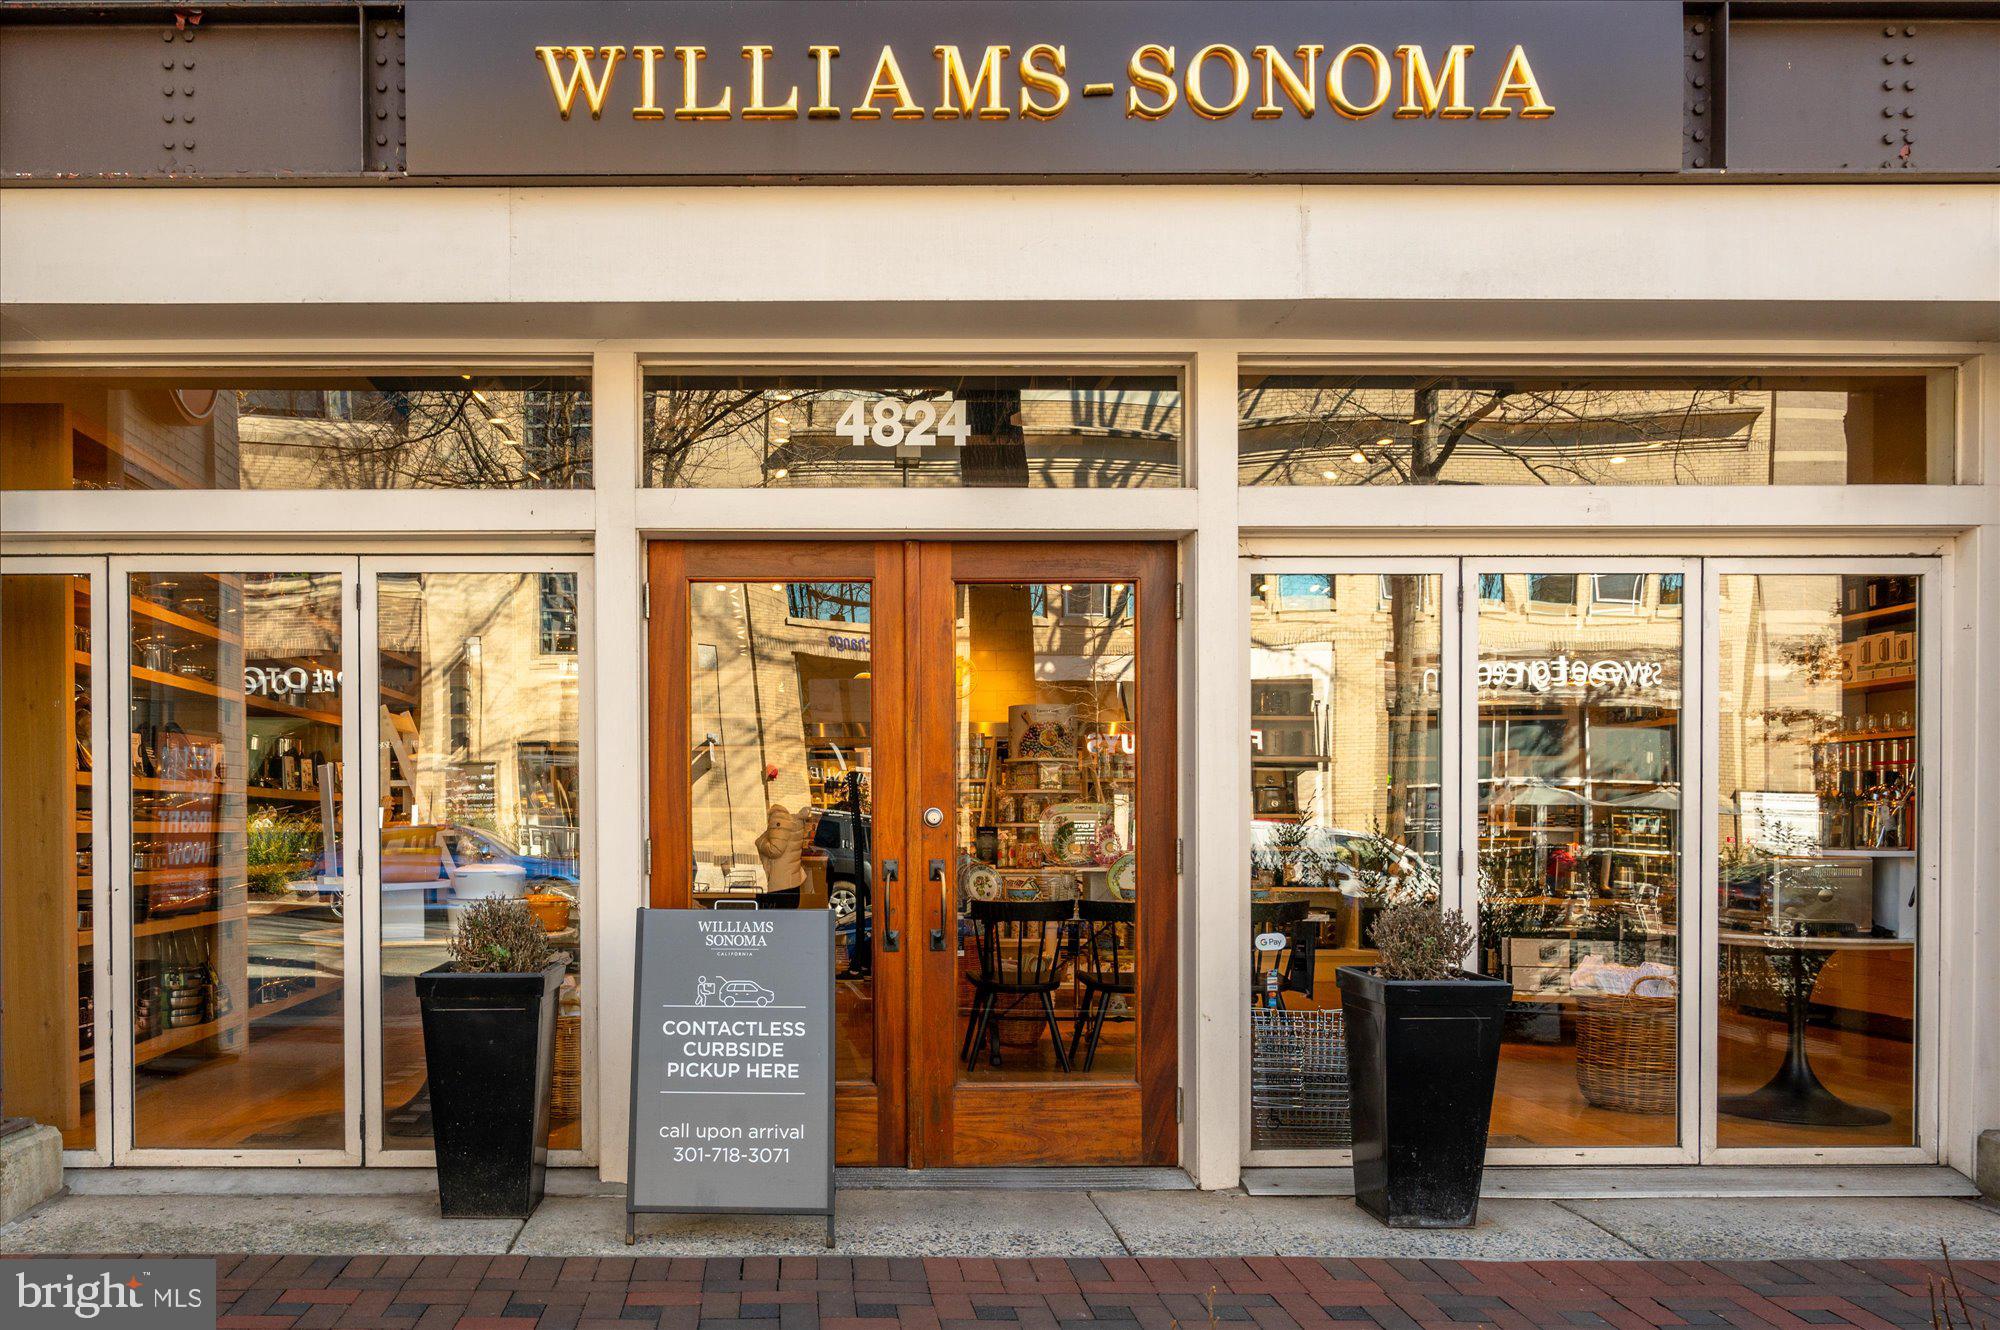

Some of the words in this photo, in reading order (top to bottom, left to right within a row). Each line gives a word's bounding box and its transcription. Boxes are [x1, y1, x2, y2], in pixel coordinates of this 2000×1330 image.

[535, 43, 1556, 121] WILLIAMS-SONOMA
[836, 397, 971, 447] 4824
[697, 921, 774, 933] WILLIAMS
[705, 934, 768, 947] SONOMA
[1269, 938, 1281, 946] Pay
[662, 1020, 806, 1037] CONTACTLESS
[683, 1041, 784, 1058] CURBSIDE
[667, 1062, 740, 1078] PICKUP
[747, 1063, 800, 1079] HERE
[659, 1123, 690, 1138] call
[696, 1126, 742, 1141] upon
[748, 1124, 804, 1139] arrival
[673, 1146, 789, 1164] 301-718-3071
